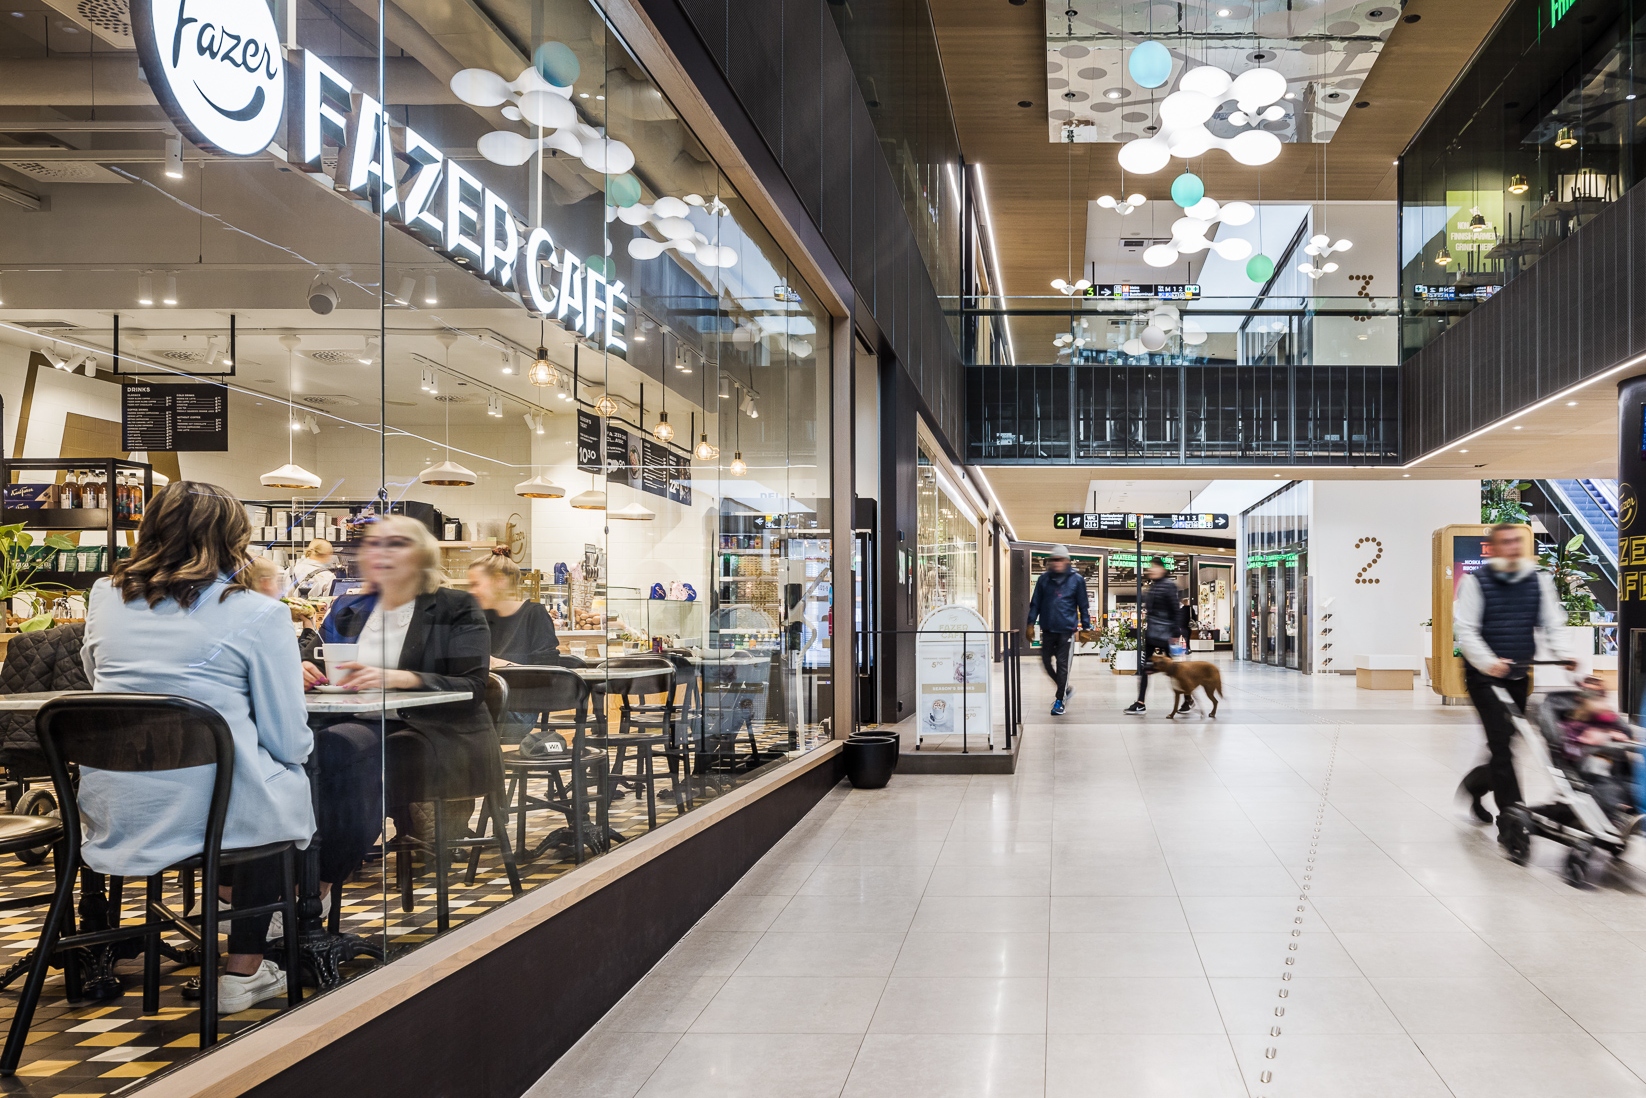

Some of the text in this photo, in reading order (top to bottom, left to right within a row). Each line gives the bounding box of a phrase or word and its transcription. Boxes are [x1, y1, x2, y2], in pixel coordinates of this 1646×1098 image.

[172, 0, 278, 80] Fazer
[304, 48, 628, 352] FAZER CAFÉ
[1348, 274, 1377, 322] 3
[1056, 516, 1065, 527] 2
[1354, 536, 1383, 584] 2
[939, 624, 968, 632] FAZER
